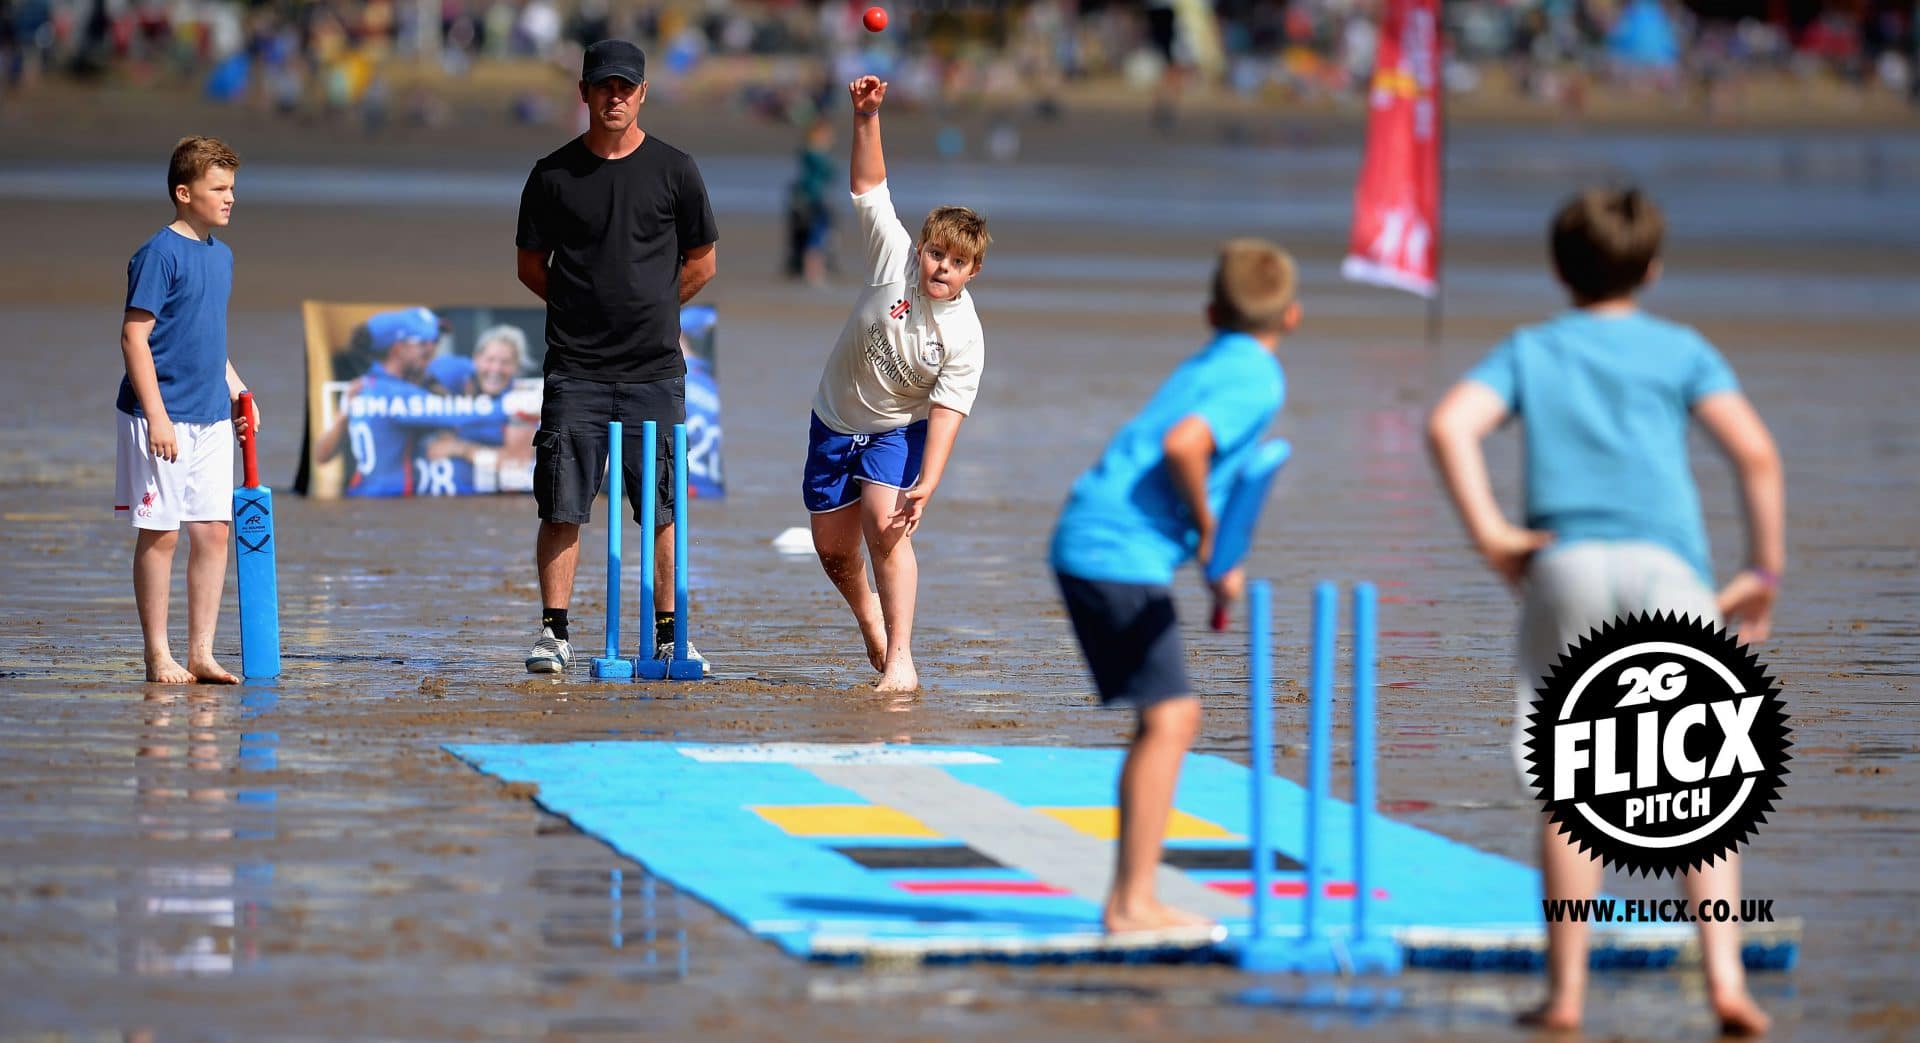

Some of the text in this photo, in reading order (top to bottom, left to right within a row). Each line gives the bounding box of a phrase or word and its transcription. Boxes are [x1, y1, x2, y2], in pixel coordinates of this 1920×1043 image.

[865, 344, 910, 388] FLOORING
[867, 322, 923, 384] SCARBOROUGH
[351, 393, 494, 416] SMASHING
